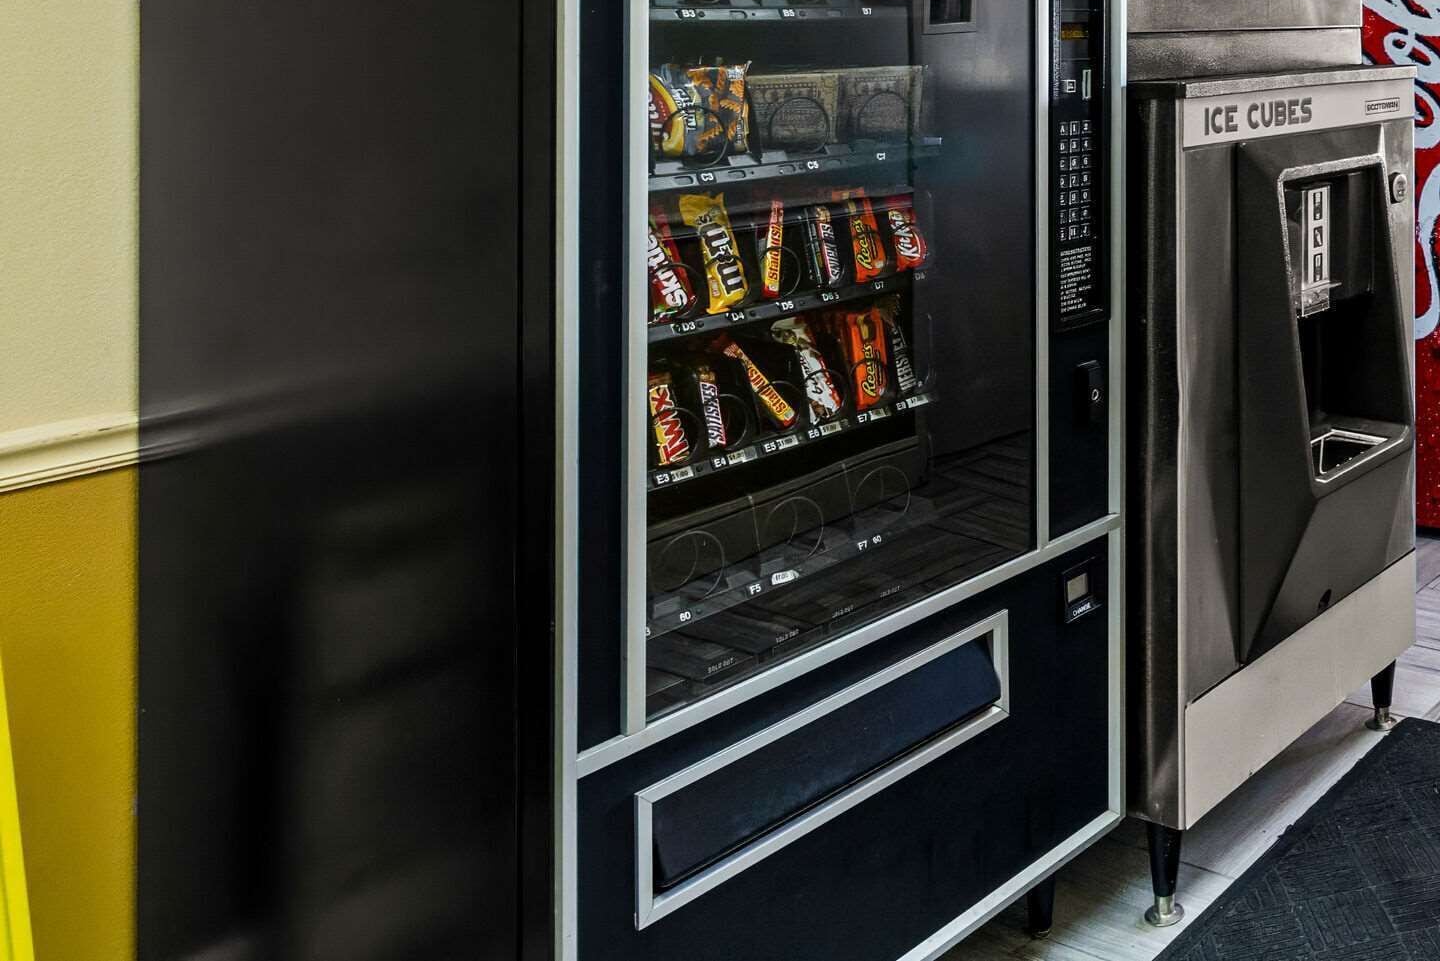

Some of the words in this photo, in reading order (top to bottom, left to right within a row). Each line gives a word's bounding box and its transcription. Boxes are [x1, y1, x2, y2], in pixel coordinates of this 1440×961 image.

[1204, 105, 1238, 136] ICE
[1247, 97, 1313, 130] CUBES
[648, 234, 688, 308] Skitle
[781, 302, 794, 310] D5
[732, 312, 745, 321] D4
[682, 321, 696, 331] D3
[857, 413, 867, 422] E7
[808, 429, 820, 439] E6
[764, 442, 777, 452] E5
[714, 457, 726, 467] E4
[656, 474, 669, 484] E3
[857, 540, 867, 550] F7
[750, 584, 761, 594] F5
[680, 611, 691, 622] 60
